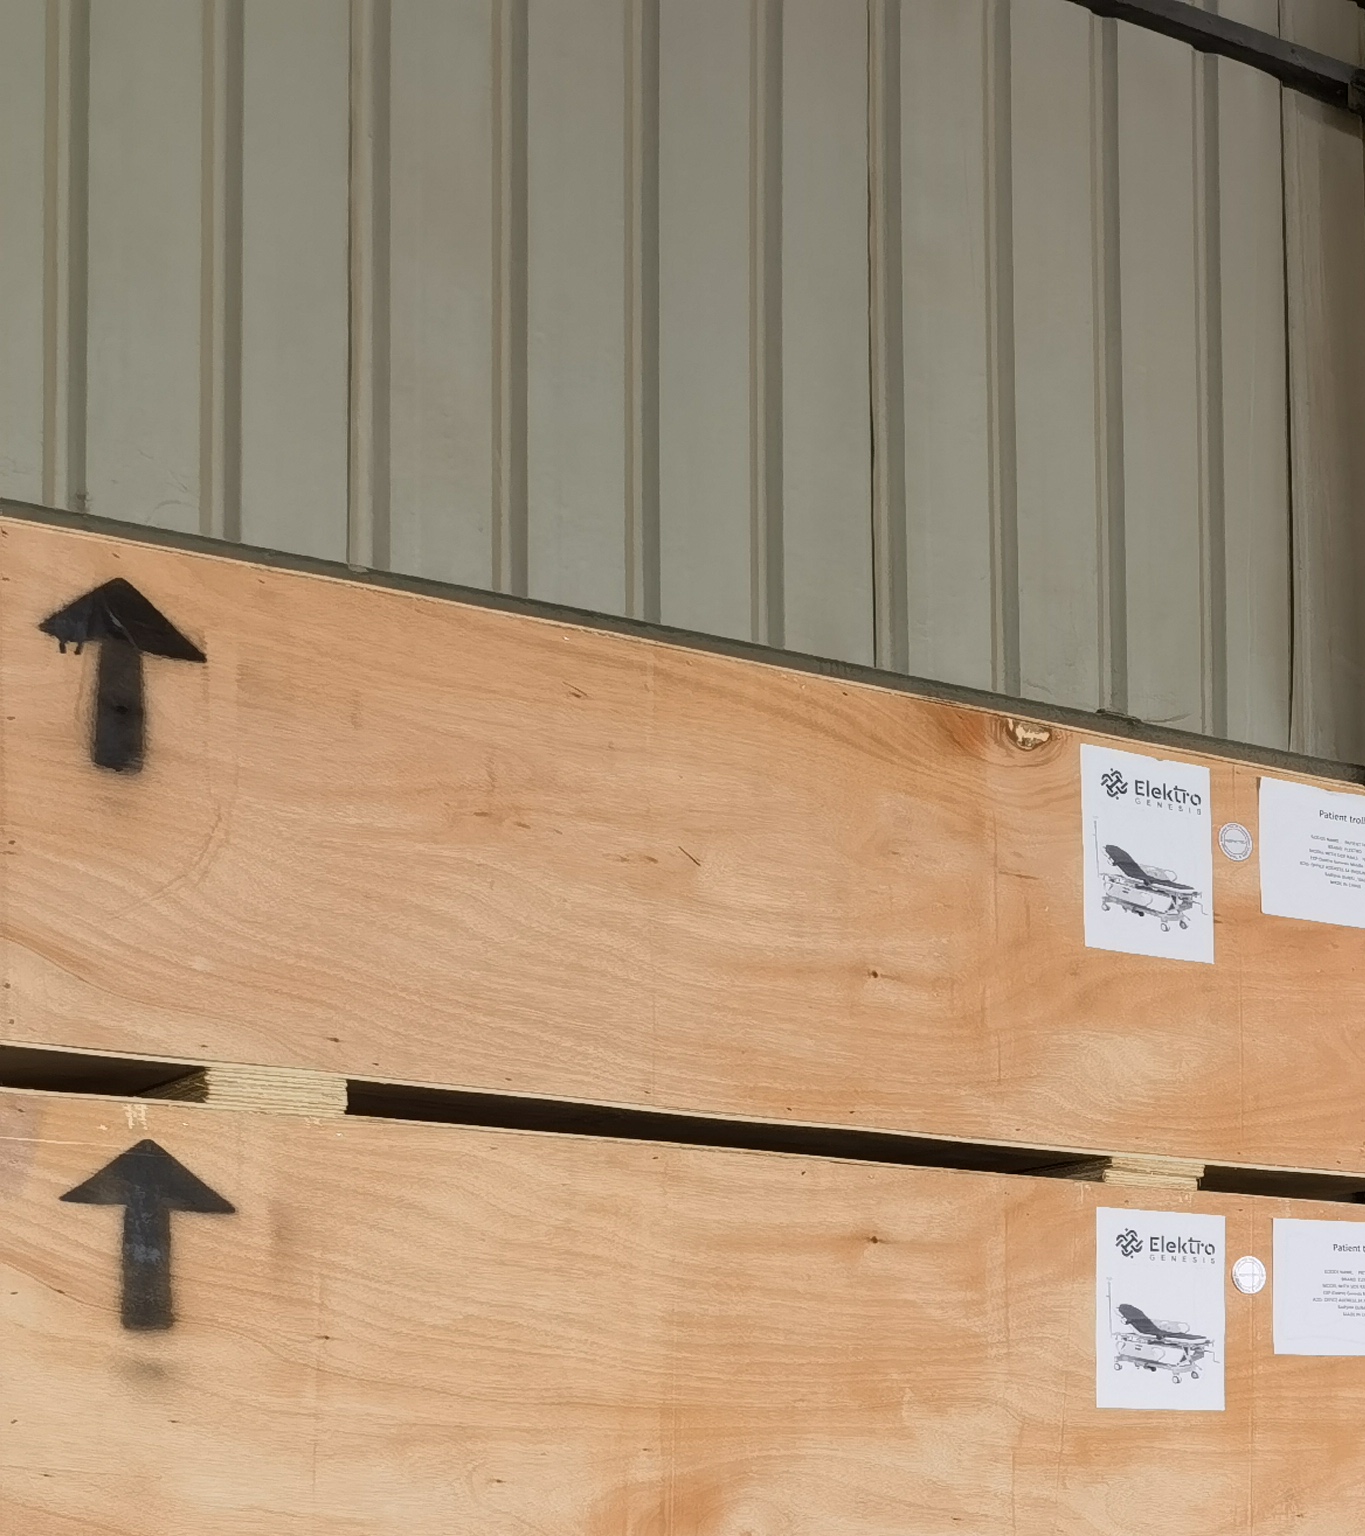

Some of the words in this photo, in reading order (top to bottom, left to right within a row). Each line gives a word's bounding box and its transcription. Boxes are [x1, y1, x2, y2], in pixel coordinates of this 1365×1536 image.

[1134, 779, 1202, 806] Elektro
[1134, 797, 1202, 815] GENESIS
[1319, 809, 1347, 822] Patient
[1150, 1235, 1216, 1255] Elektro
[1332, 1243, 1360, 1253] Patient
[1149, 1254, 1216, 1264] GENESIS
